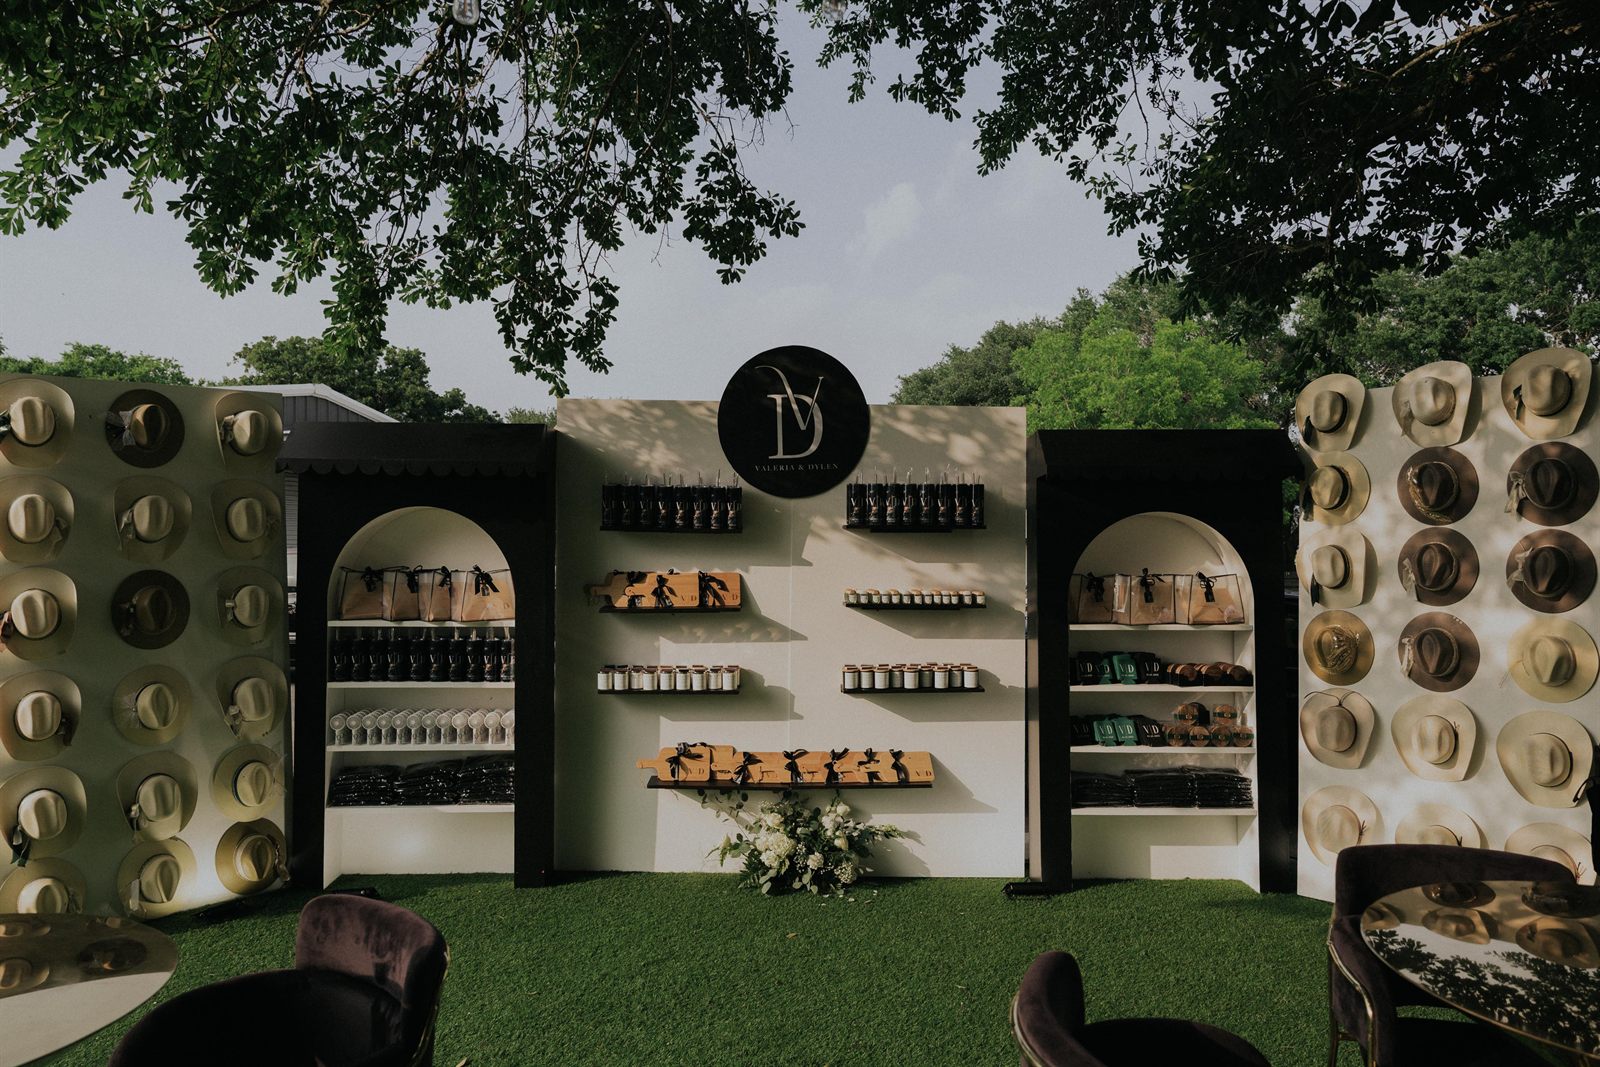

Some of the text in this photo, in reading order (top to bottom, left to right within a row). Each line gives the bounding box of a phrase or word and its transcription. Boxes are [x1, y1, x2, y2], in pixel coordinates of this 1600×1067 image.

[754, 463, 840, 472] VALERIA & DYLEN
